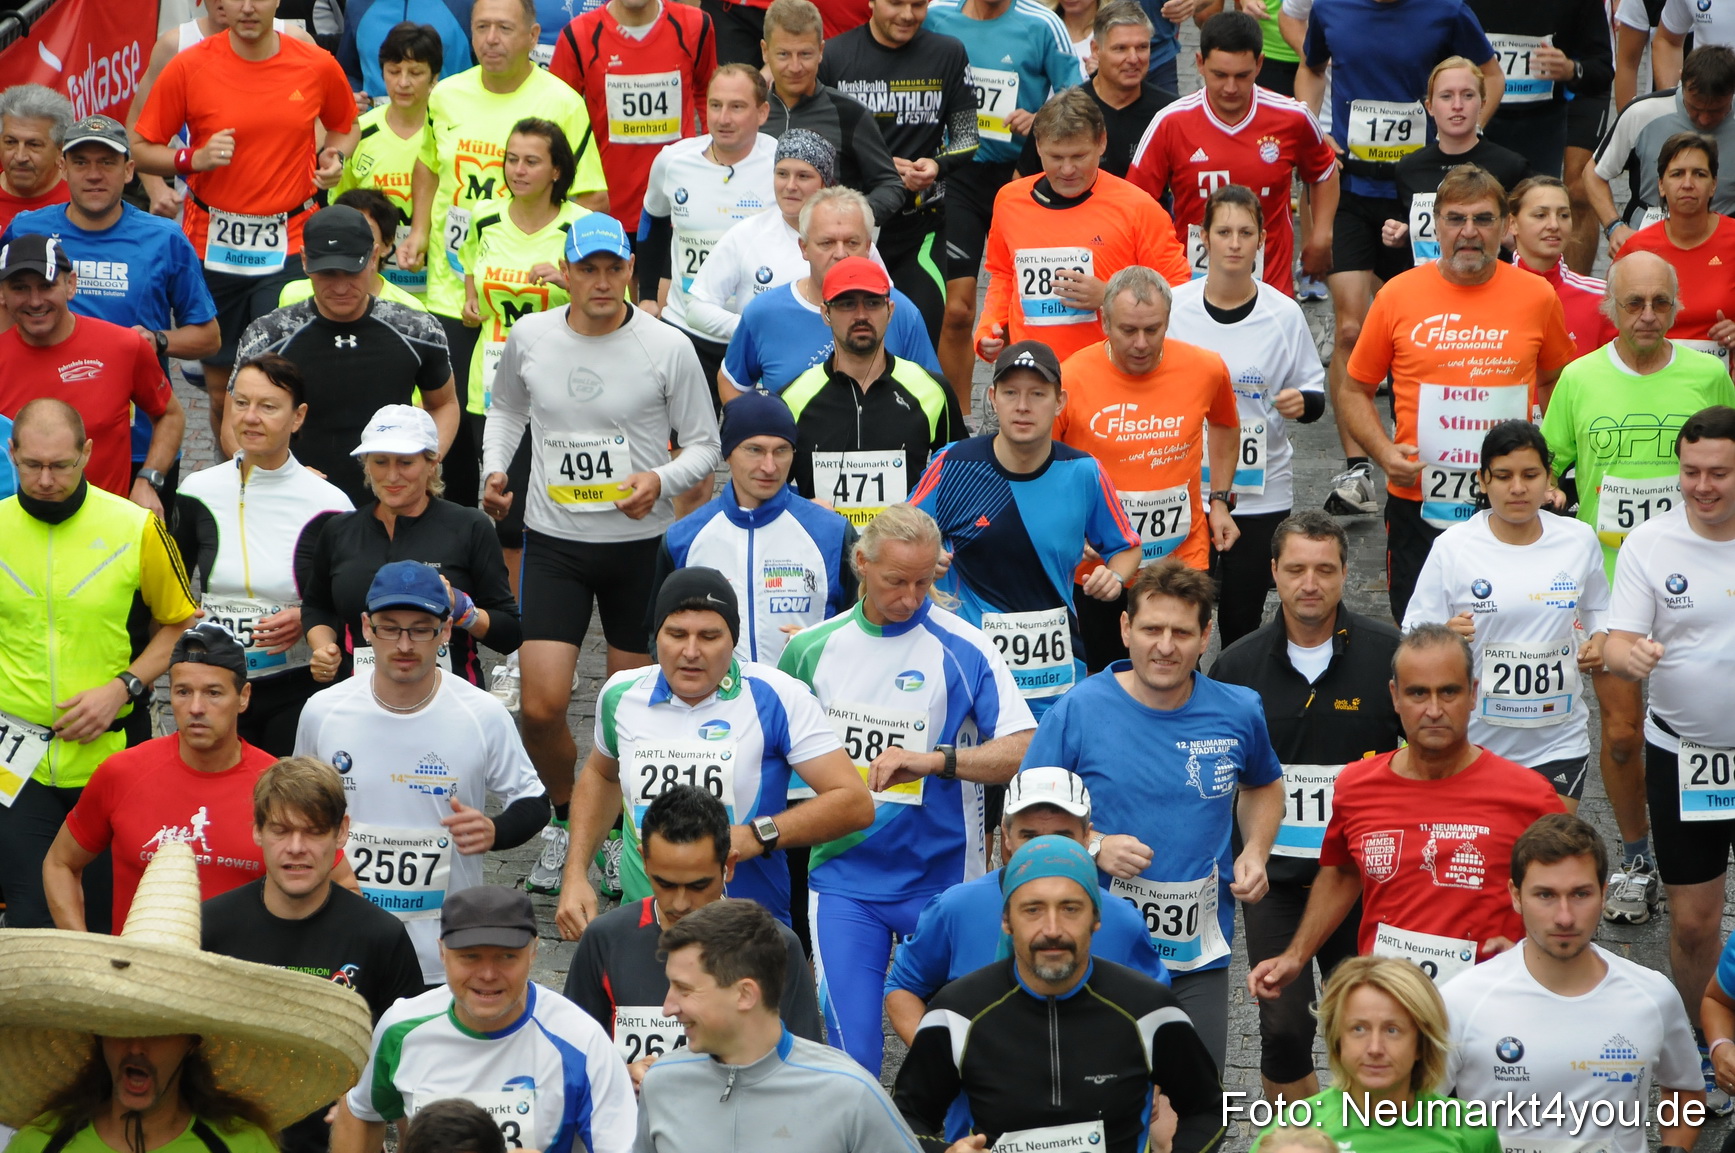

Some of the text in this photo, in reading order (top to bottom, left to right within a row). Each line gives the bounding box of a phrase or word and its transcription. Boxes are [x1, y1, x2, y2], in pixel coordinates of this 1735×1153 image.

[607, 80, 669, 88] PARTL Neumarkt
[622, 91, 668, 117] 504
[1353, 104, 1415, 116] PARTL Neumarkt
[623, 122, 668, 133] Bernhard
[1366, 118, 1412, 142] 179
[1368, 147, 1404, 159] Marcus
[216, 218, 280, 248] 2073
[679, 236, 699, 245] PARTL
[225, 251, 266, 266] Andreas
[1041, 255, 1078, 263] Neumarkt
[1042, 302, 1067, 314] Felix
[1427, 325, 1509, 342] Fischer
[1434, 342, 1503, 350] AUTOMOBILE
[1439, 387, 1490, 402] Jede
[1107, 415, 1184, 433] Fischer
[1115, 429, 1180, 442] AUTOMOBILE
[544, 438, 611, 448] PARTL Neumarkt
[560, 450, 614, 482] 494
[815, 460, 889, 470] PARTL Neumarkt
[832, 472, 884, 503] 471
[1603, 484, 1674, 495] PARTL Neumarkt
[574, 488, 604, 501] Peter
[1137, 497, 1177, 508] Neumarkt
[764, 566, 804, 578] PANORAMA
[764, 577, 782, 588] TOUR
[226, 606, 268, 614] Neumarkt
[984, 619, 1057, 630] PARTL Neumarkt
[993, 630, 1066, 666] 2946
[1485, 648, 1560, 660] PARTL Neumarkt
[1493, 660, 1564, 696] 2081
[1496, 702, 1538, 714] Samantha
[828, 708, 910, 729] PARTL Neumarkt
[1190, 738, 1239, 748] NEUMARKTER
[634, 750, 716, 760] PARTL Neumarkt
[1190, 746, 1231, 754] STADTLAUF
[1690, 753, 1735, 786] 20
[640, 764, 723, 800] 2816
[1420, 824, 1490, 835] 11. NEUMARKTER
[1430, 831, 1478, 840] STADTLAUF
[348, 830, 433, 847] PARTL Neumarkt
[1364, 837, 1395, 846] IMMER
[1365, 846, 1396, 854] WIEDER
[217, 856, 260, 871] POWER
[1366, 854, 1393, 866] NEU
[354, 848, 442, 886] 2567
[1366, 866, 1392, 874] MARKT
[1450, 865, 1486, 875] 19.09.2010
[1113, 878, 1199, 900] PARTL Neumarkt
[1127, 896, 1200, 937] 630
[1378, 933, 1456, 958] PARTL Neumarkt
[617, 1018, 647, 1028] PARTL
[1494, 1066, 1530, 1075] PARTL
[1494, 1074, 1530, 1082] Neumarkt
